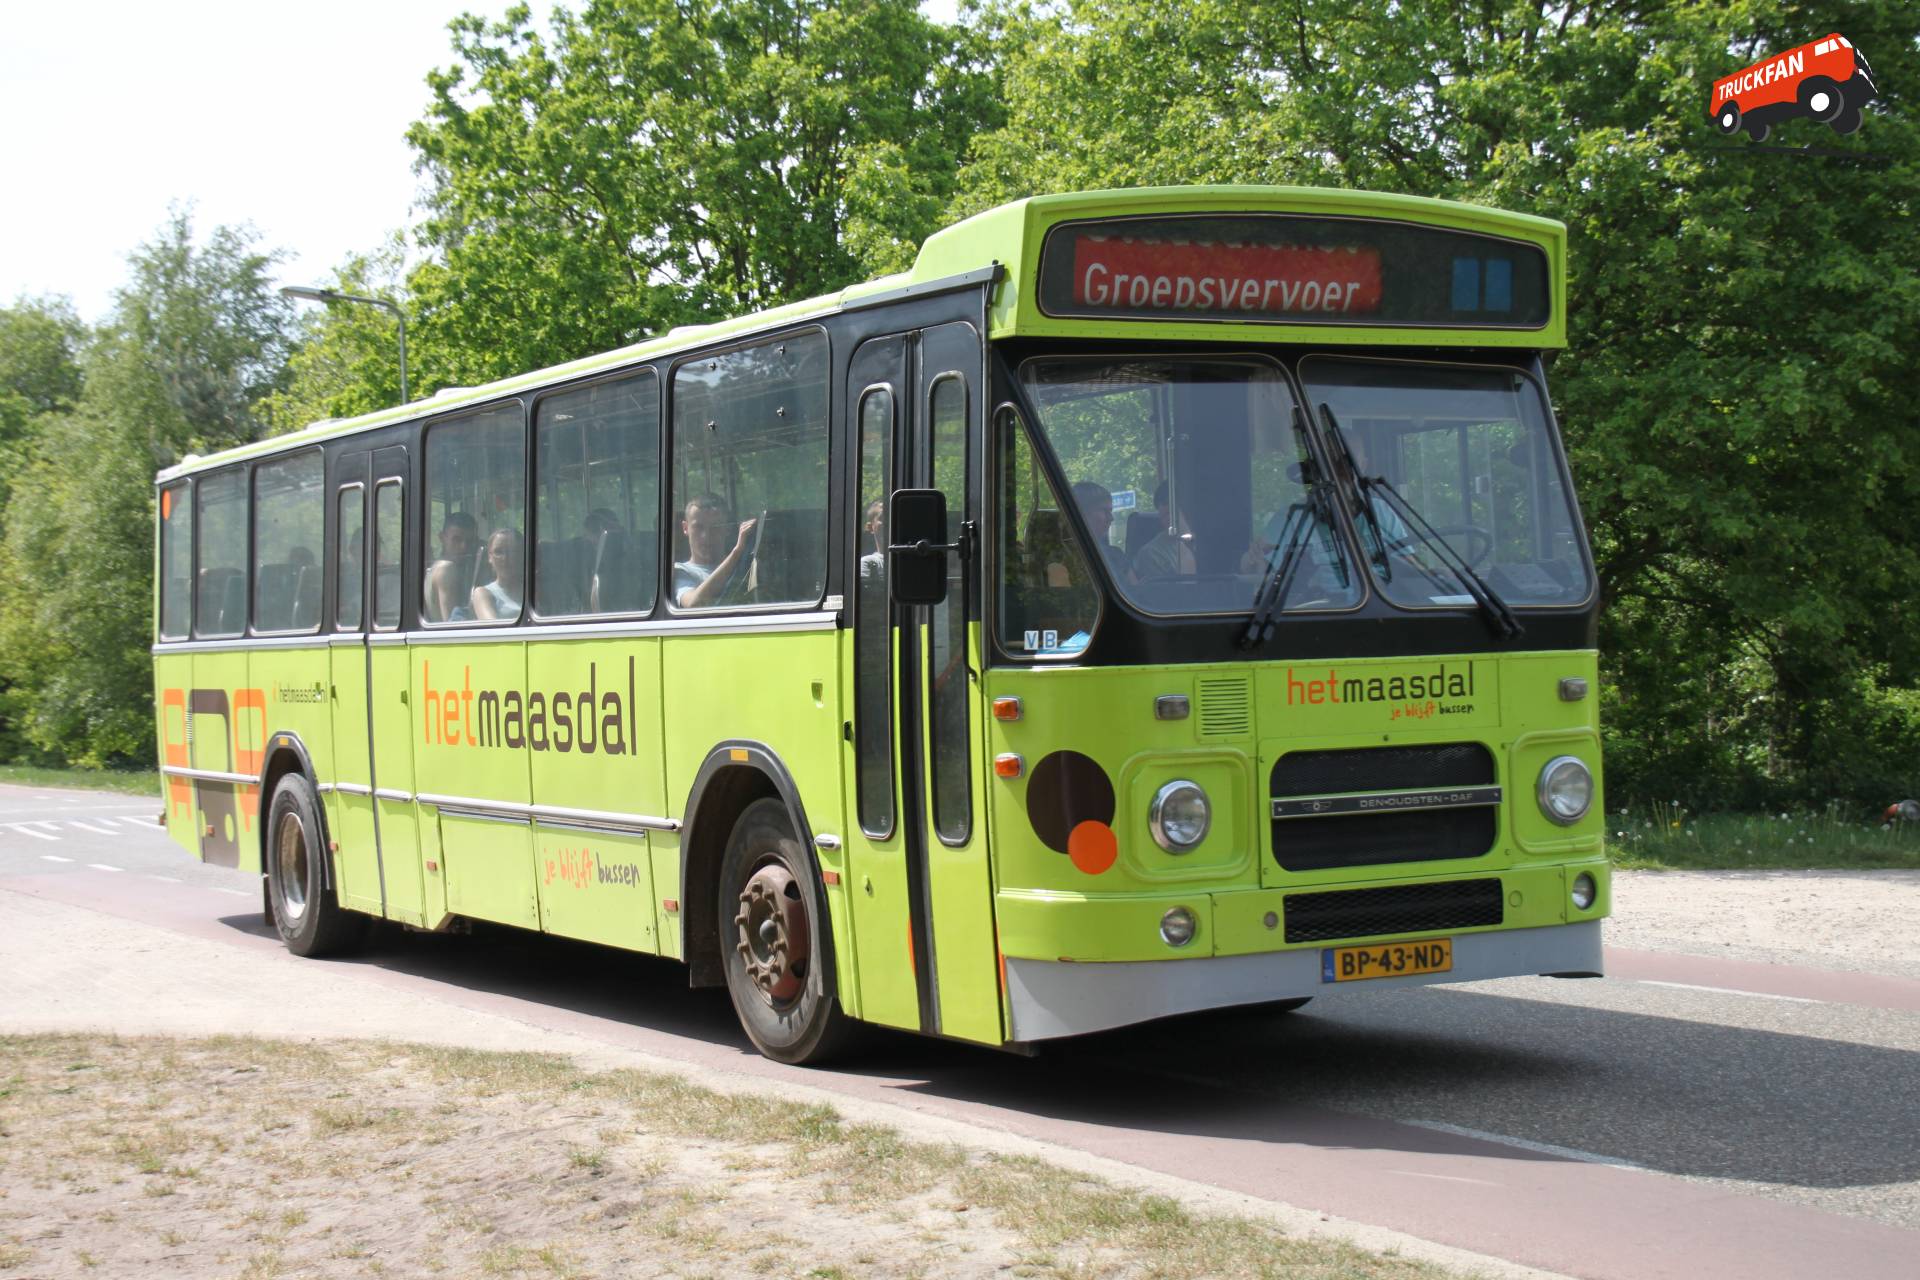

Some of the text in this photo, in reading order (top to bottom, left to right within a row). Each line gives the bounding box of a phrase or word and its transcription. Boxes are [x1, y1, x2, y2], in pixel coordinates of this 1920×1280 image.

[1084, 262, 1361, 312] Groepsvervoer
[1287, 660, 1474, 705] hetmaasdal
[423, 655, 638, 756] hetmaasdal
[1390, 700, 1474, 721] je blijft bussen
[543, 847, 641, 889] je blijft bussen
[1341, 943, 1445, 977] BP-43-ND
